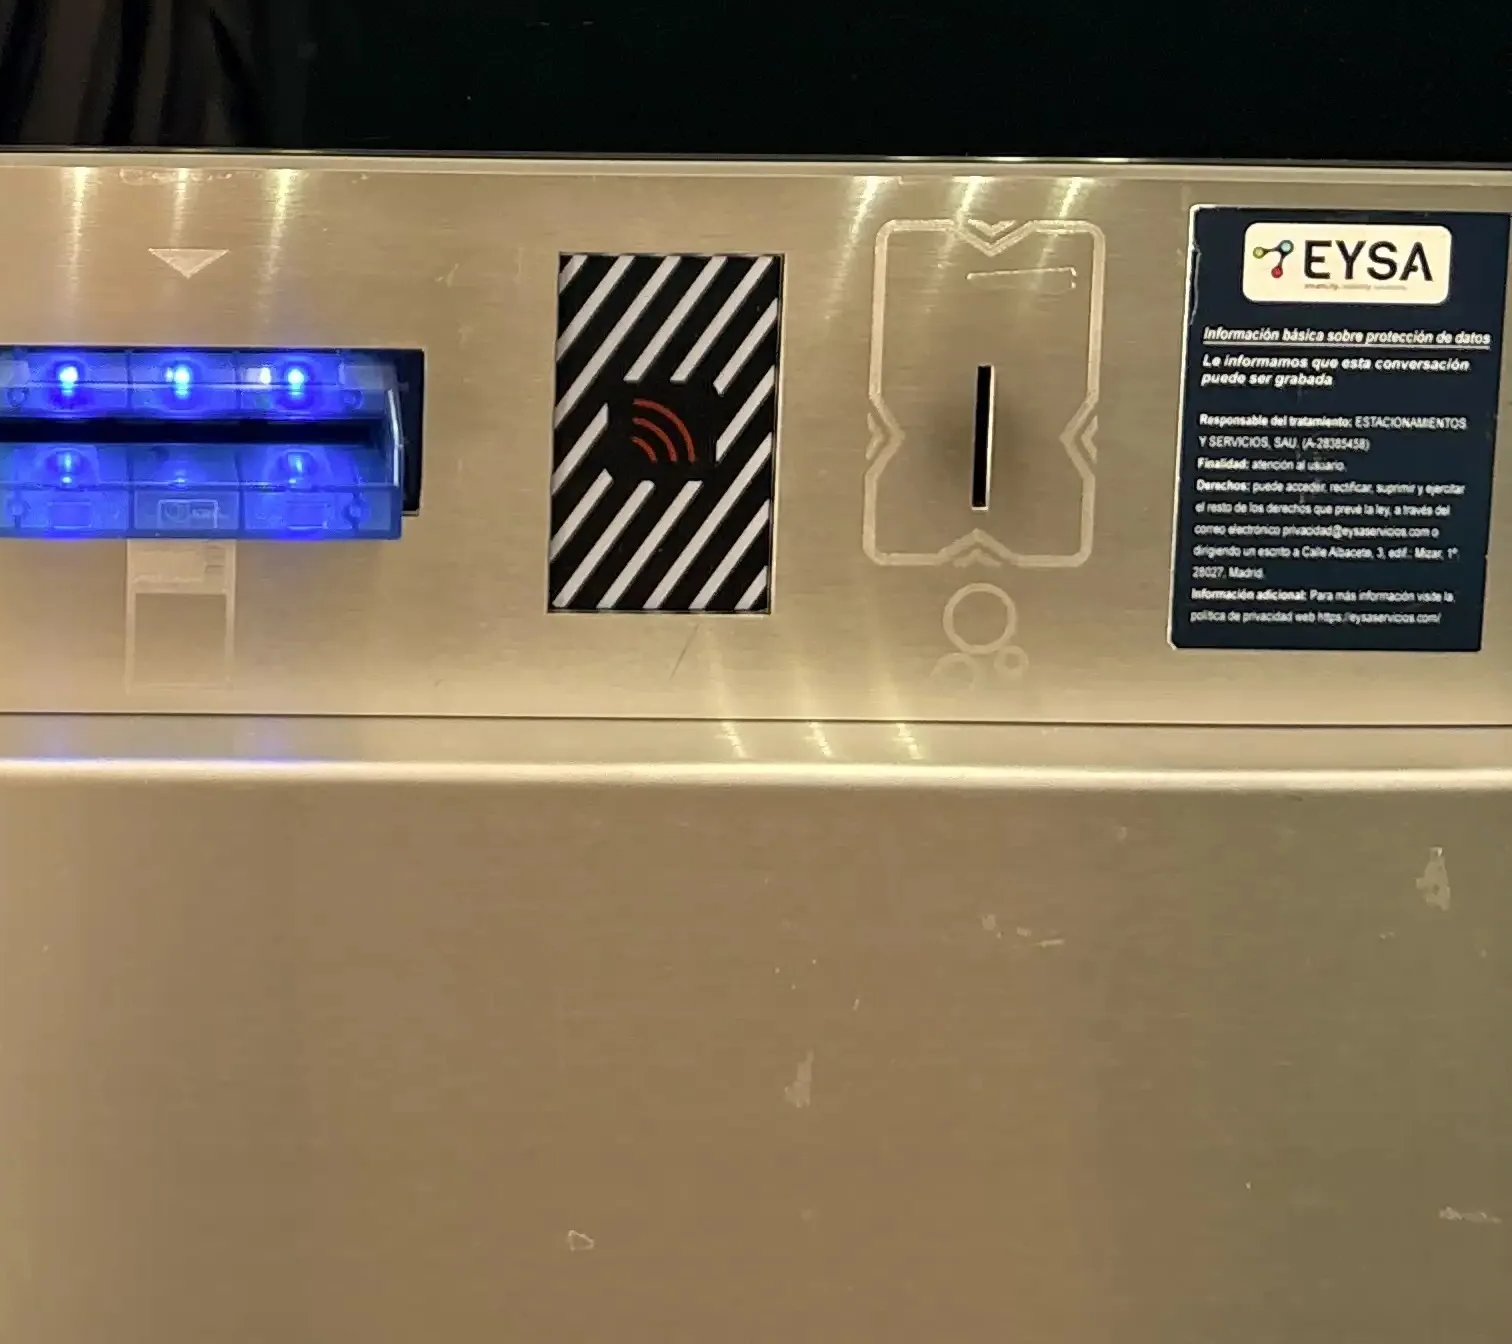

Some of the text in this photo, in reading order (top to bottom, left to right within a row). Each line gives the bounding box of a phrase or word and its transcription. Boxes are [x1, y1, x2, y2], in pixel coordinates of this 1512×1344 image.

[1304, 240, 1433, 282] EYSA
[1203, 327, 1491, 345] Información básica sobre protección de datos
[1203, 354, 1470, 371] Le informamos que esta conversación
[1201, 372, 1333, 387] puede ser grabada
[1199, 413, 1269, 428] Responsable
[1270, 414, 1288, 427] del
[1198, 435, 1207, 448] Y
[1197, 456, 1249, 470] Finalidad:
[1296, 460, 1305, 472] al
[1196, 478, 1250, 492] Derechos:
[1417, 484, 1424, 496] y
[1195, 501, 1206, 513] el
[1207, 502, 1233, 514] resto
[1234, 502, 1248, 514] de
[1249, 502, 1264, 514] los
[1266, 502, 1312, 514] derechos
[1313, 504, 1333, 516] que
[1364, 504, 1374, 515] la
[1394, 506, 1401, 515] a
[1435, 504, 1451, 516] del
[1194, 525, 1226, 536] correo
[1431, 528, 1440, 538] o
[1242, 547, 1256, 557] un
[1292, 548, 1300, 558] a
[1191, 588, 1255, 601] Información
[1309, 589, 1334, 602] Para
[1335, 590, 1357, 602] más
[1358, 590, 1415, 602] información
[1227, 612, 1241, 623] de
[1242, 611, 1293, 623] privacidad
[1294, 612, 1316, 623] web
